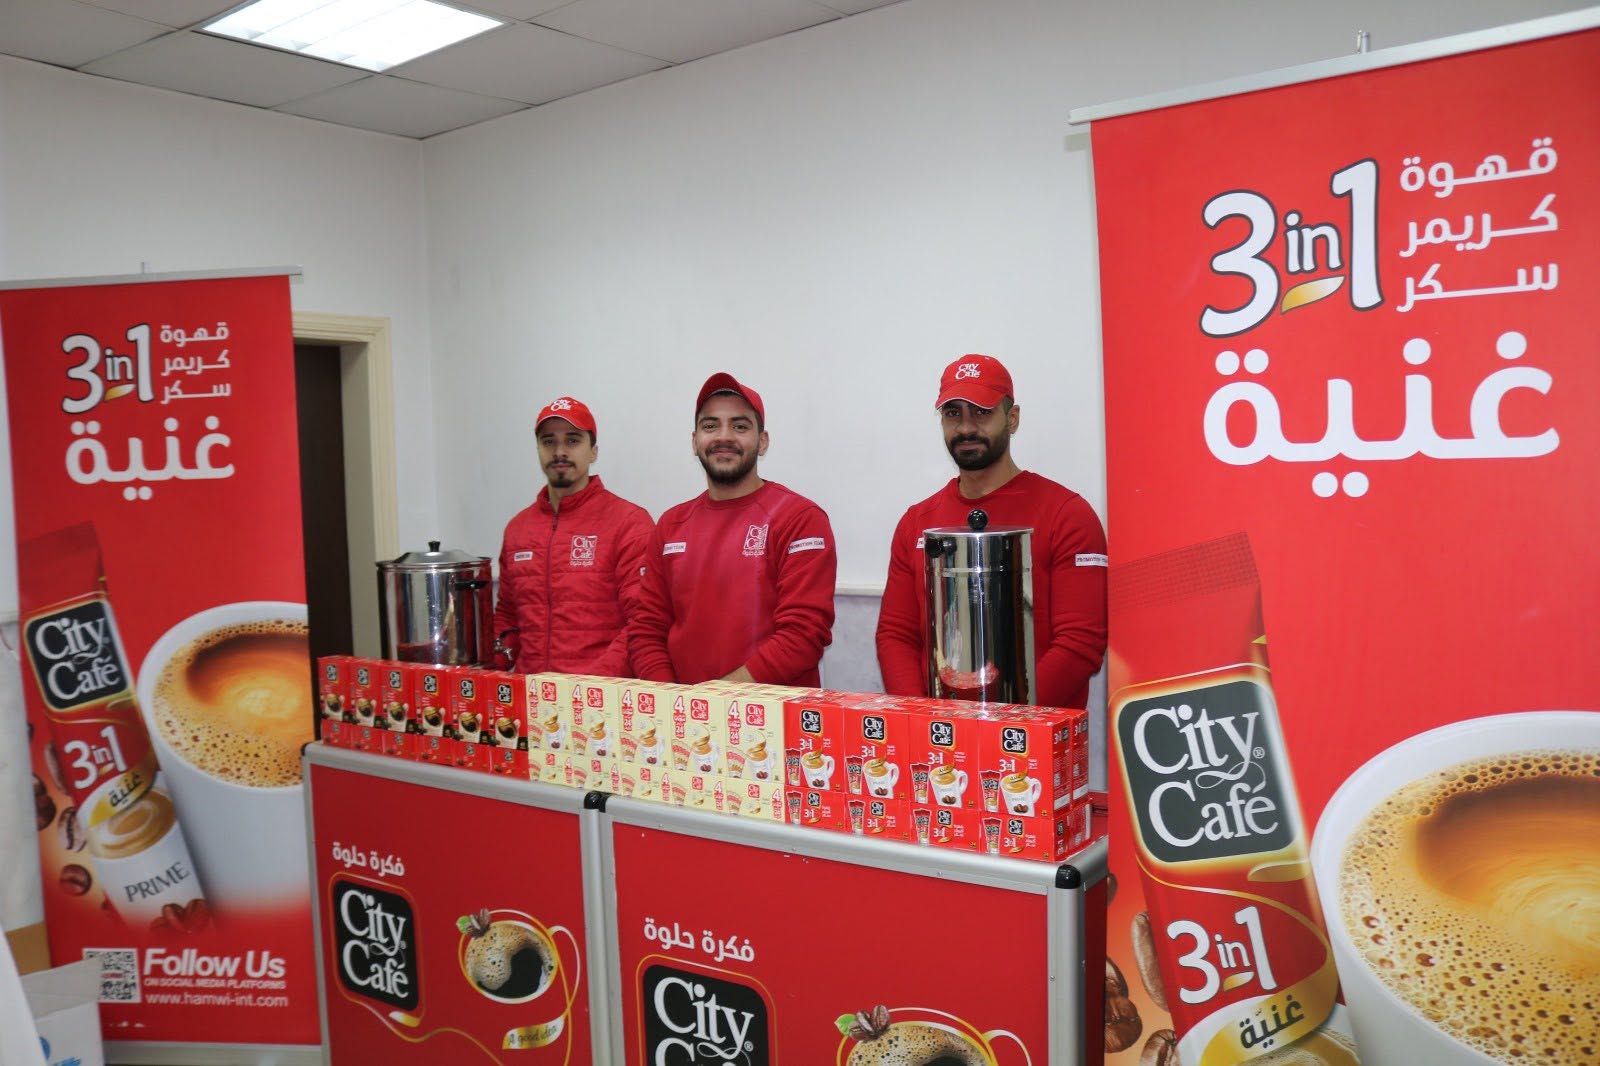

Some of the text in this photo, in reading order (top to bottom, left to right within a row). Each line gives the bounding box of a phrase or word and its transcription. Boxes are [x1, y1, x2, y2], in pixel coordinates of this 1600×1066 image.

[1399, 137, 1558, 198] قهوة
[1399, 193, 1559, 258] كريمر
[1396, 263, 1559, 313] سكر
[160, 322, 229, 347] قهوة
[160, 349, 231, 376] كريمر
[160, 380, 232, 405] سكر
[1203, 331, 1561, 499] غنية
[65, 415, 236, 501] غنية
[36, 618, 106, 660] City
[48, 656, 120, 700] Café
[1133, 704, 1261, 780] City
[1148, 780, 1279, 847] Café
[124, 861, 191, 903] PRIME
[332, 841, 405, 877] فكرة حلوة
[341, 889, 407, 951] City
[643, 916, 755, 962] فكرة حلوة
[144, 948, 286, 978] Follow Us
[342, 939, 409, 999] Café
[653, 976, 755, 1059] City
